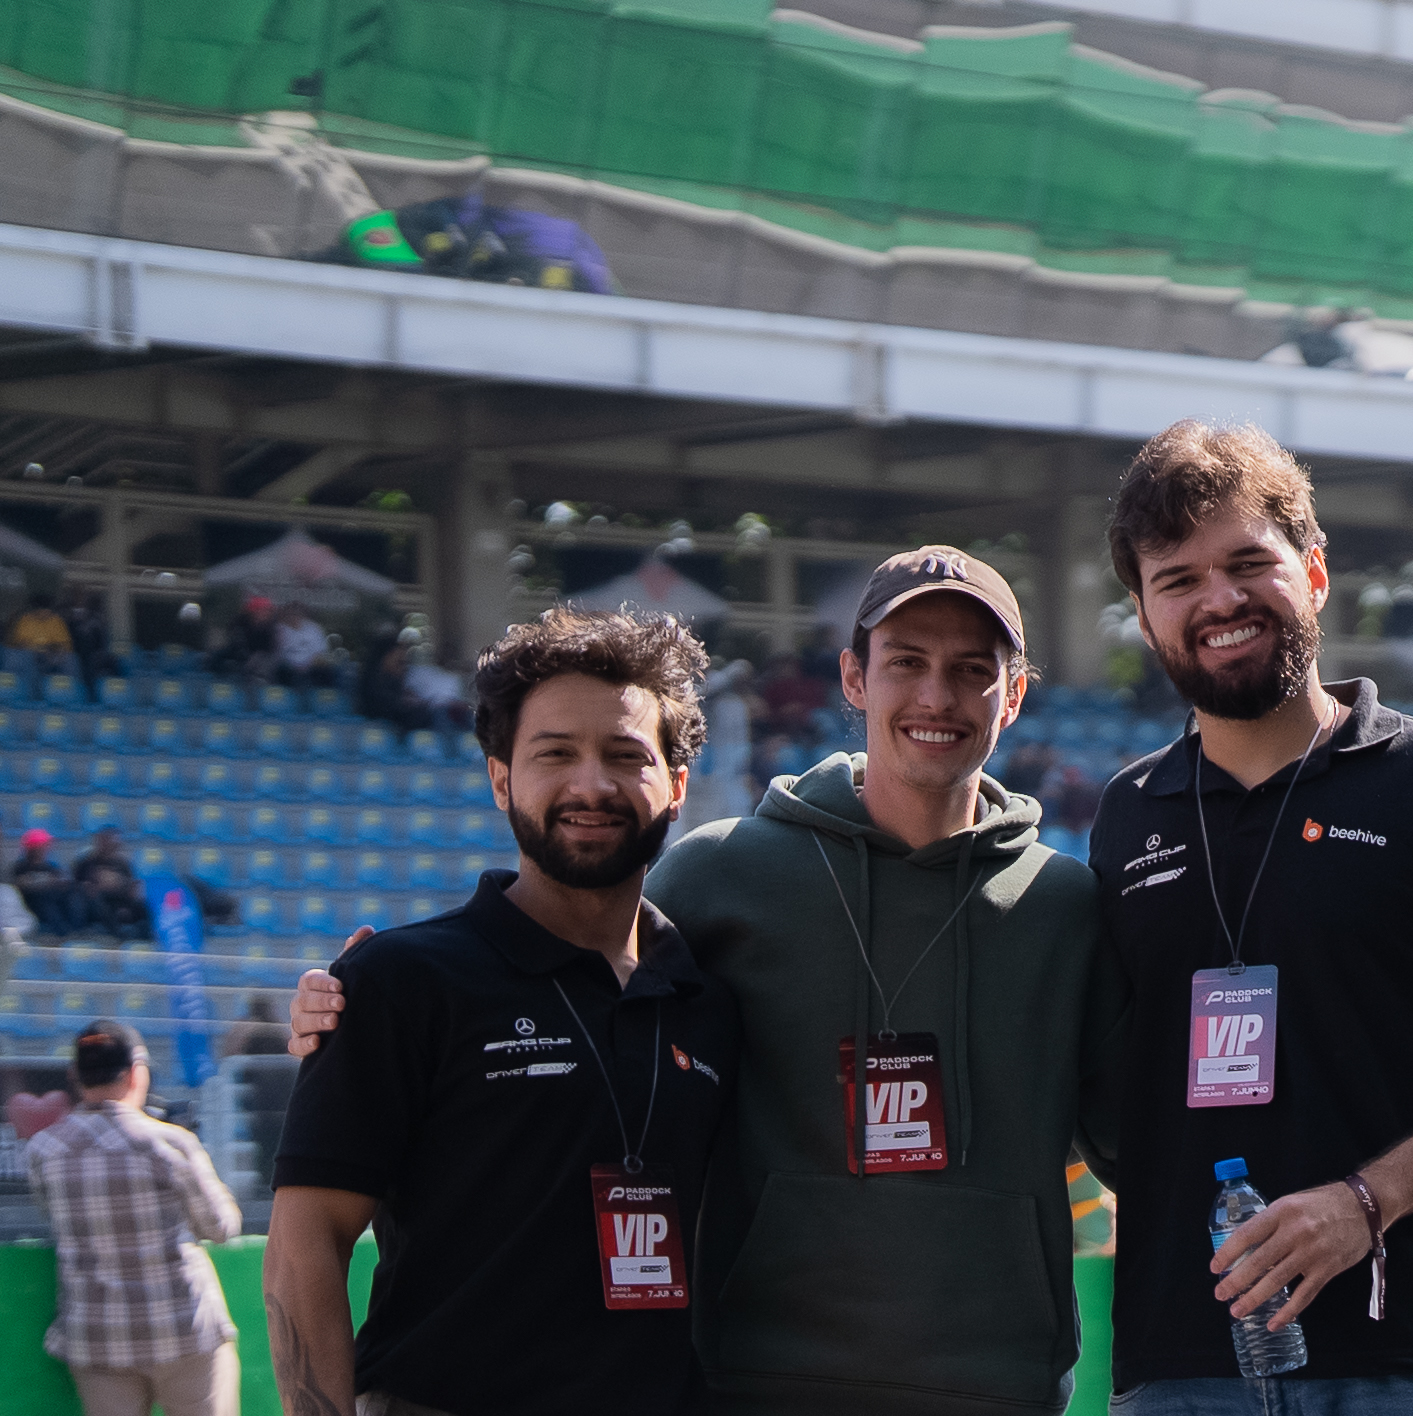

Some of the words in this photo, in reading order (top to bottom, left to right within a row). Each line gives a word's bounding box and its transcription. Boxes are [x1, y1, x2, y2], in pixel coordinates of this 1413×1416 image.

[1328, 825, 1387, 846] beehive
[1159, 844, 1186, 857] CUP
[1224, 988, 1272, 998] PADDOCK
[1224, 996, 1252, 1004] CLUB
[1207, 1013, 1264, 1058] VIP
[538, 1037, 572, 1046] CUP
[879, 1055, 934, 1064] PADDOCK
[865, 1081, 928, 1124] VIP
[626, 1187, 671, 1195] PADDOCK
[613, 1213, 668, 1257] VIP
